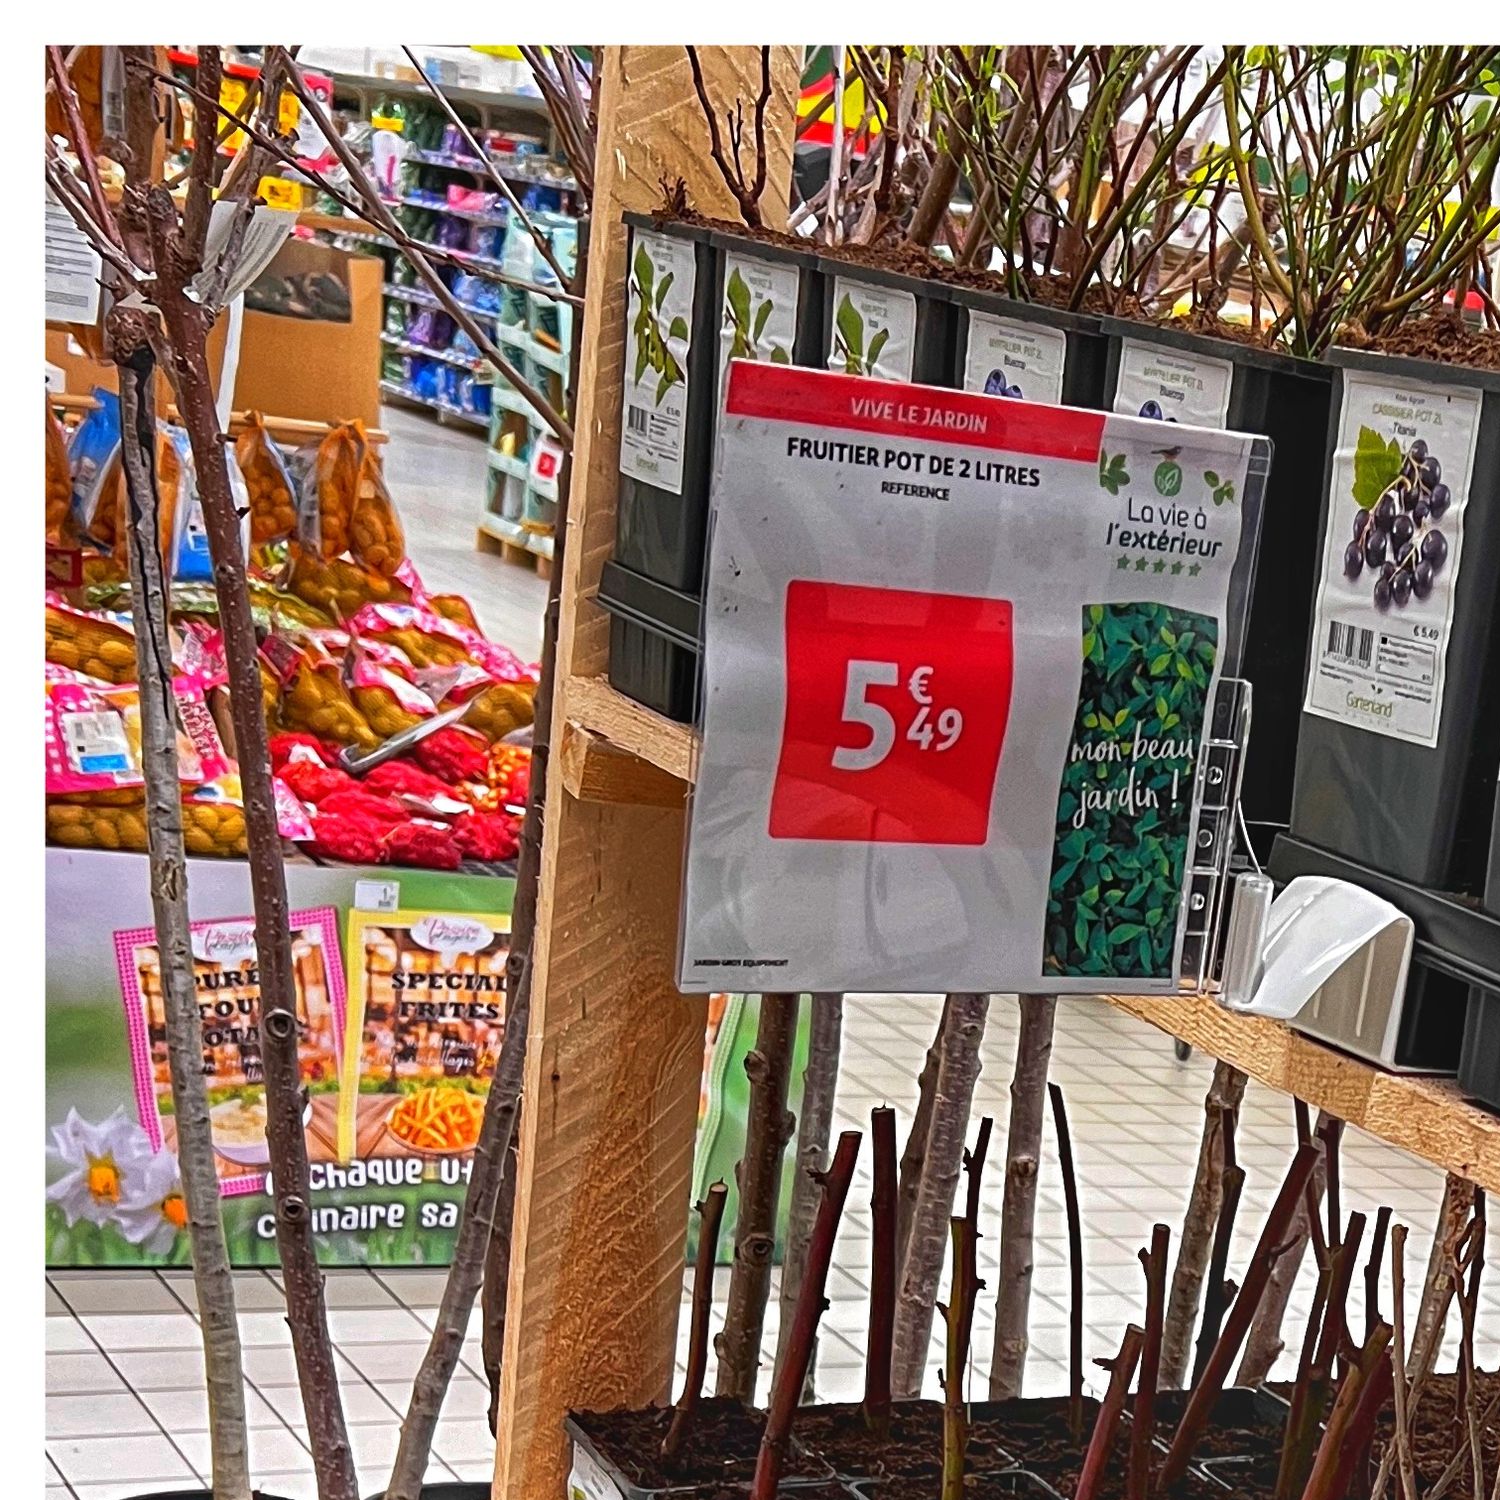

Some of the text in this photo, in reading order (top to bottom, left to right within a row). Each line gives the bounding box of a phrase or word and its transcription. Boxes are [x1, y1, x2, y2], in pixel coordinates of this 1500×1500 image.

[851, 397, 988, 434] VIVE LE JARDIN
[787, 437, 1040, 487] FRUITIER POT DE 2 LITRES
[881, 480, 950, 501] REFERENCE
[1128, 498, 1207, 530] La vie à
[1106, 522, 1223, 558] l'extérieur
[831, 658, 897, 772] 5
[906, 707, 963, 752] 49
[1071, 720, 1195, 762] mon beau
[1073, 766, 1159, 829] jardin
[391, 972, 508, 992] SPECIAL
[199, 998, 260, 1020] TOU
[400, 1001, 499, 1020] FRITES
[256, 1203, 404, 1238] cinaire
